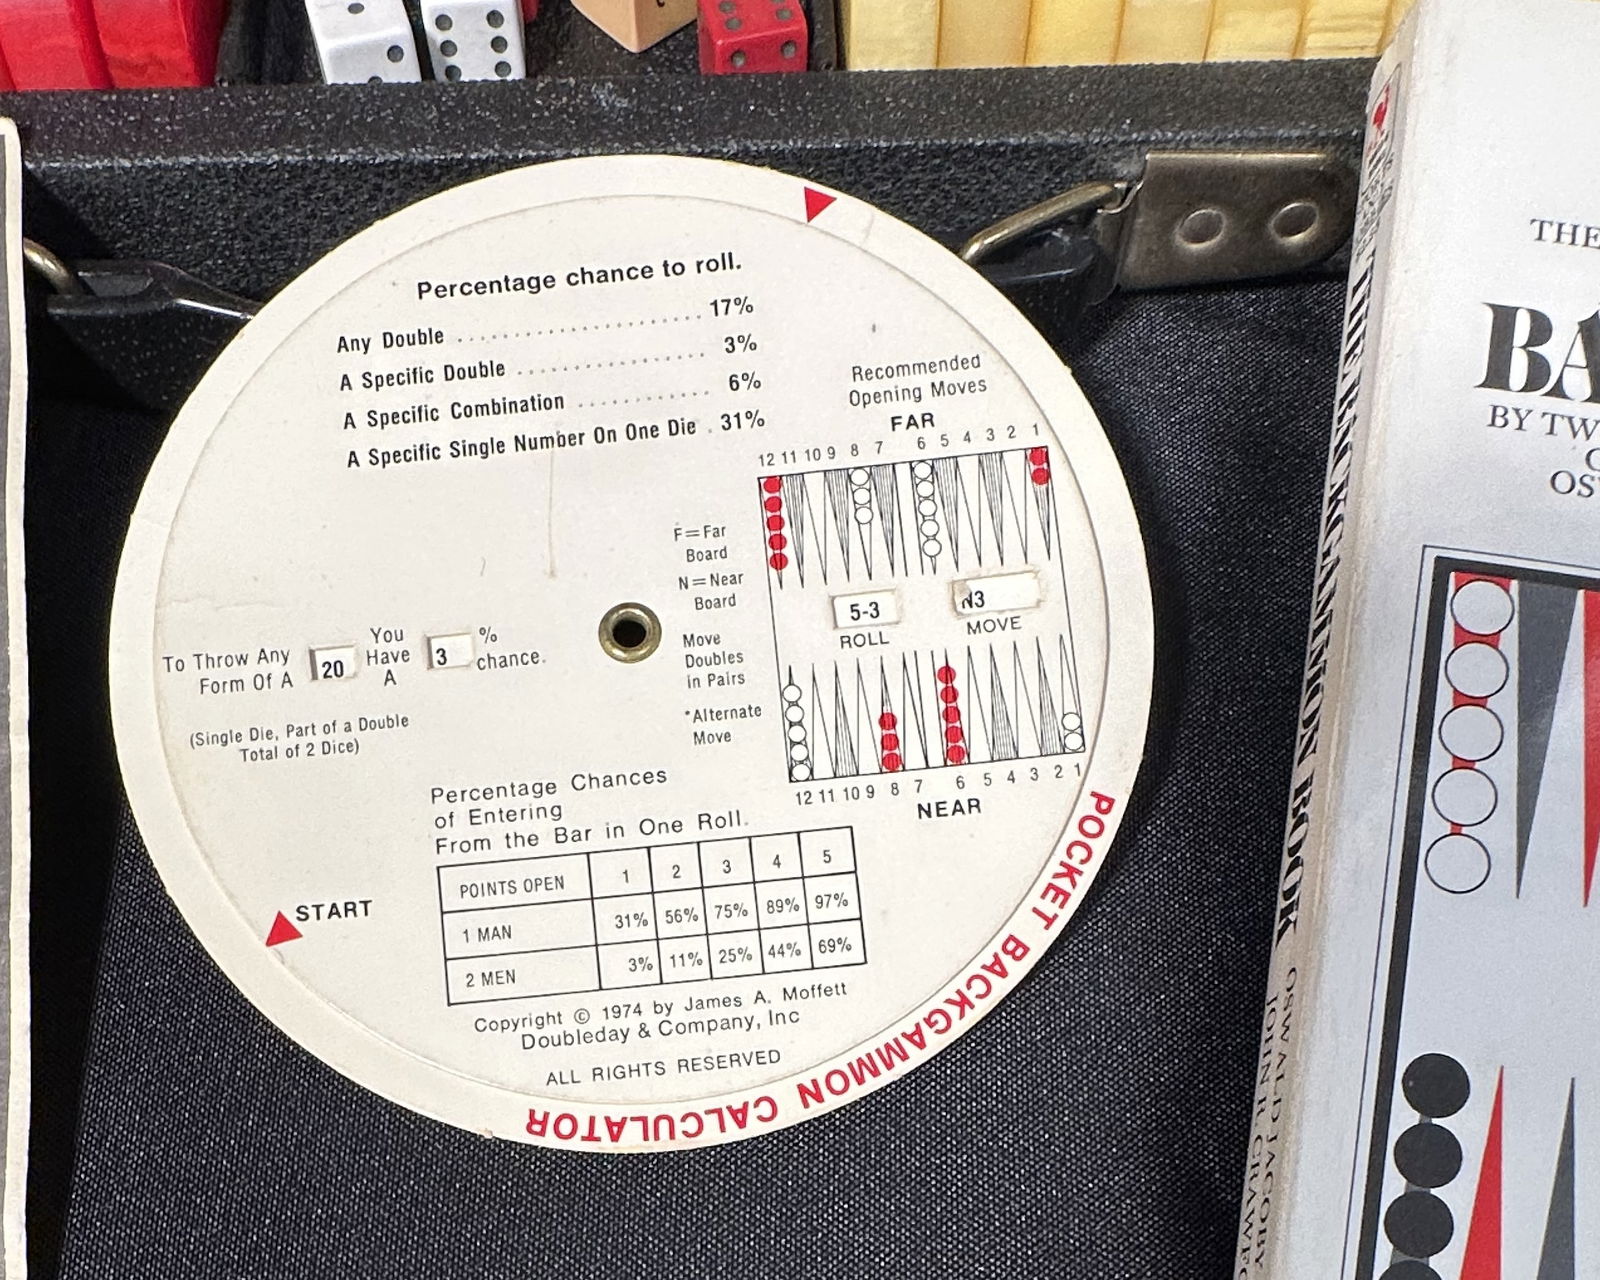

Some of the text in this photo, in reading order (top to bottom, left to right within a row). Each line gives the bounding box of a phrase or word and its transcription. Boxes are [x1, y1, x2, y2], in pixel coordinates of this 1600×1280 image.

[1530, 218, 1600, 250] THE
[418, 252, 741, 300] Percentage chance to roll.
[337, 296, 753, 355] Any Double 17%
[1342, 247, 1376, 382] THE
[340, 334, 757, 392] A Specific Double 3%
[852, 354, 980, 382] Recommended
[344, 372, 761, 430] A Specific Combination 6%
[849, 379, 987, 409] Opening Moves
[891, 412, 935, 432] FAR
[1487, 404, 1533, 432] BY
[347, 409, 765, 469] A Specific Single Number On One Die 31%
[759, 424, 1038, 466] 12 11 10 9 8 7 6 5 4 3 2 1
[1550, 470, 1600, 498] OS
[686, 546, 727, 562] Board
[1297, 366, 1364, 768] BACKGAMMON
[694, 593, 736, 610] Board
[850, 603, 881, 621] 5-3
[370, 627, 403, 643] You
[479, 627, 497, 643] %
[967, 614, 1021, 635] MOVE
[683, 633, 720, 647] Move
[840, 631, 889, 649] ROLL
[162, 648, 289, 672] To Throw Any
[321, 660, 345, 679] 20
[367, 650, 409, 665] Have
[435, 648, 448, 666] 3
[477, 652, 545, 670] chance.
[685, 651, 743, 668] Doubles
[200, 671, 293, 694] Form Of A
[384, 669, 396, 686] A
[688, 672, 745, 688] in Pairs
[190, 714, 408, 749] (Single Die, Part of a Double
[693, 731, 731, 745] Move
[240, 739, 359, 762] Total of 2 Dice)
[431, 770, 667, 804] Percentage Chances
[796, 763, 1080, 805] 12 11 10 9 8 7 6 5 4 3 2 1
[435, 805, 562, 829] of Entering
[917, 798, 981, 819] NEAR
[436, 810, 748, 854] From the Bar in One Roll.
[1275, 768, 1316, 950] BOOK
[460, 850, 831, 898] POINTS OPEN 1 2 3 4 5
[296, 900, 372, 922] START
[463, 893, 848, 943] 1 MAN 31% 56% 75% 89% 97%
[466, 937, 852, 987] 2 MEN 3% 11% 25% 44% 69%
[526, 790, 1116, 1142] POCKET BACKGAMMON CALCULATOR
[474, 1012, 562, 1033] Copyright
[603, 1003, 642, 1020] 1974
[653, 1001, 673, 1017] by
[684, 996, 742, 1011] James
[754, 990, 771, 1004] A.
[783, 983, 847, 1001] Moffett
[522, 1010, 799, 1050] Doubleday & Company, Inc
[1260, 995, 1277, 1086] JOHN
[546, 1050, 780, 1086] ALL RIGHTS RESERVED
[1255, 967, 1298, 1276] OSWALD JACOBY
